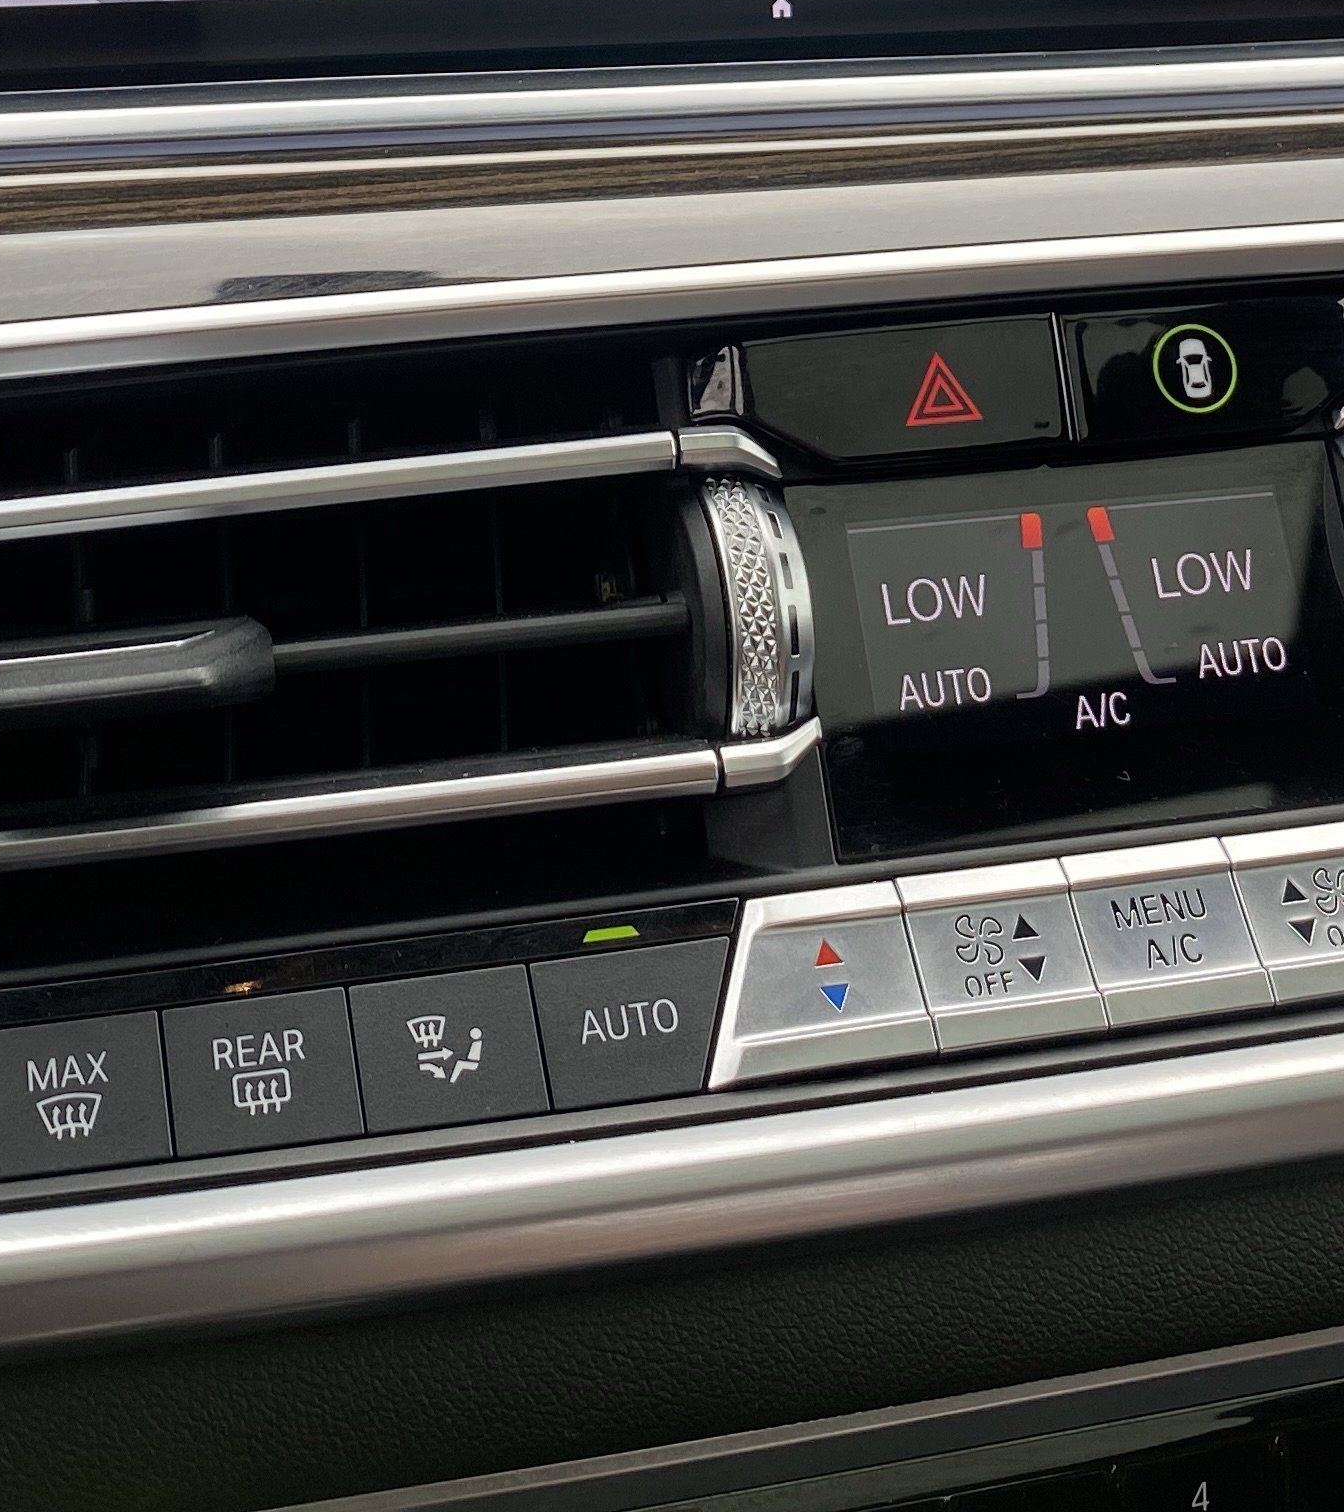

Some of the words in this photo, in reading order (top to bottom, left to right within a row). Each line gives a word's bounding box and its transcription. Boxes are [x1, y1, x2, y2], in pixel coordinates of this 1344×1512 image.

[1151, 549, 1251, 599] LOW
[881, 574, 985, 626] LOW
[1199, 636, 1286, 679] AUTO
[899, 667, 992, 711] AUTO
[1075, 691, 1131, 730] A/C
[1109, 887, 1207, 929] MENU
[1147, 933, 1203, 969] A/C
[964, 970, 1013, 998] OFF
[581, 998, 679, 1045] AUTO
[212, 1029, 306, 1070] REAR
[26, 1051, 110, 1091] MAX
[1191, 1481, 1210, 1512] 4
